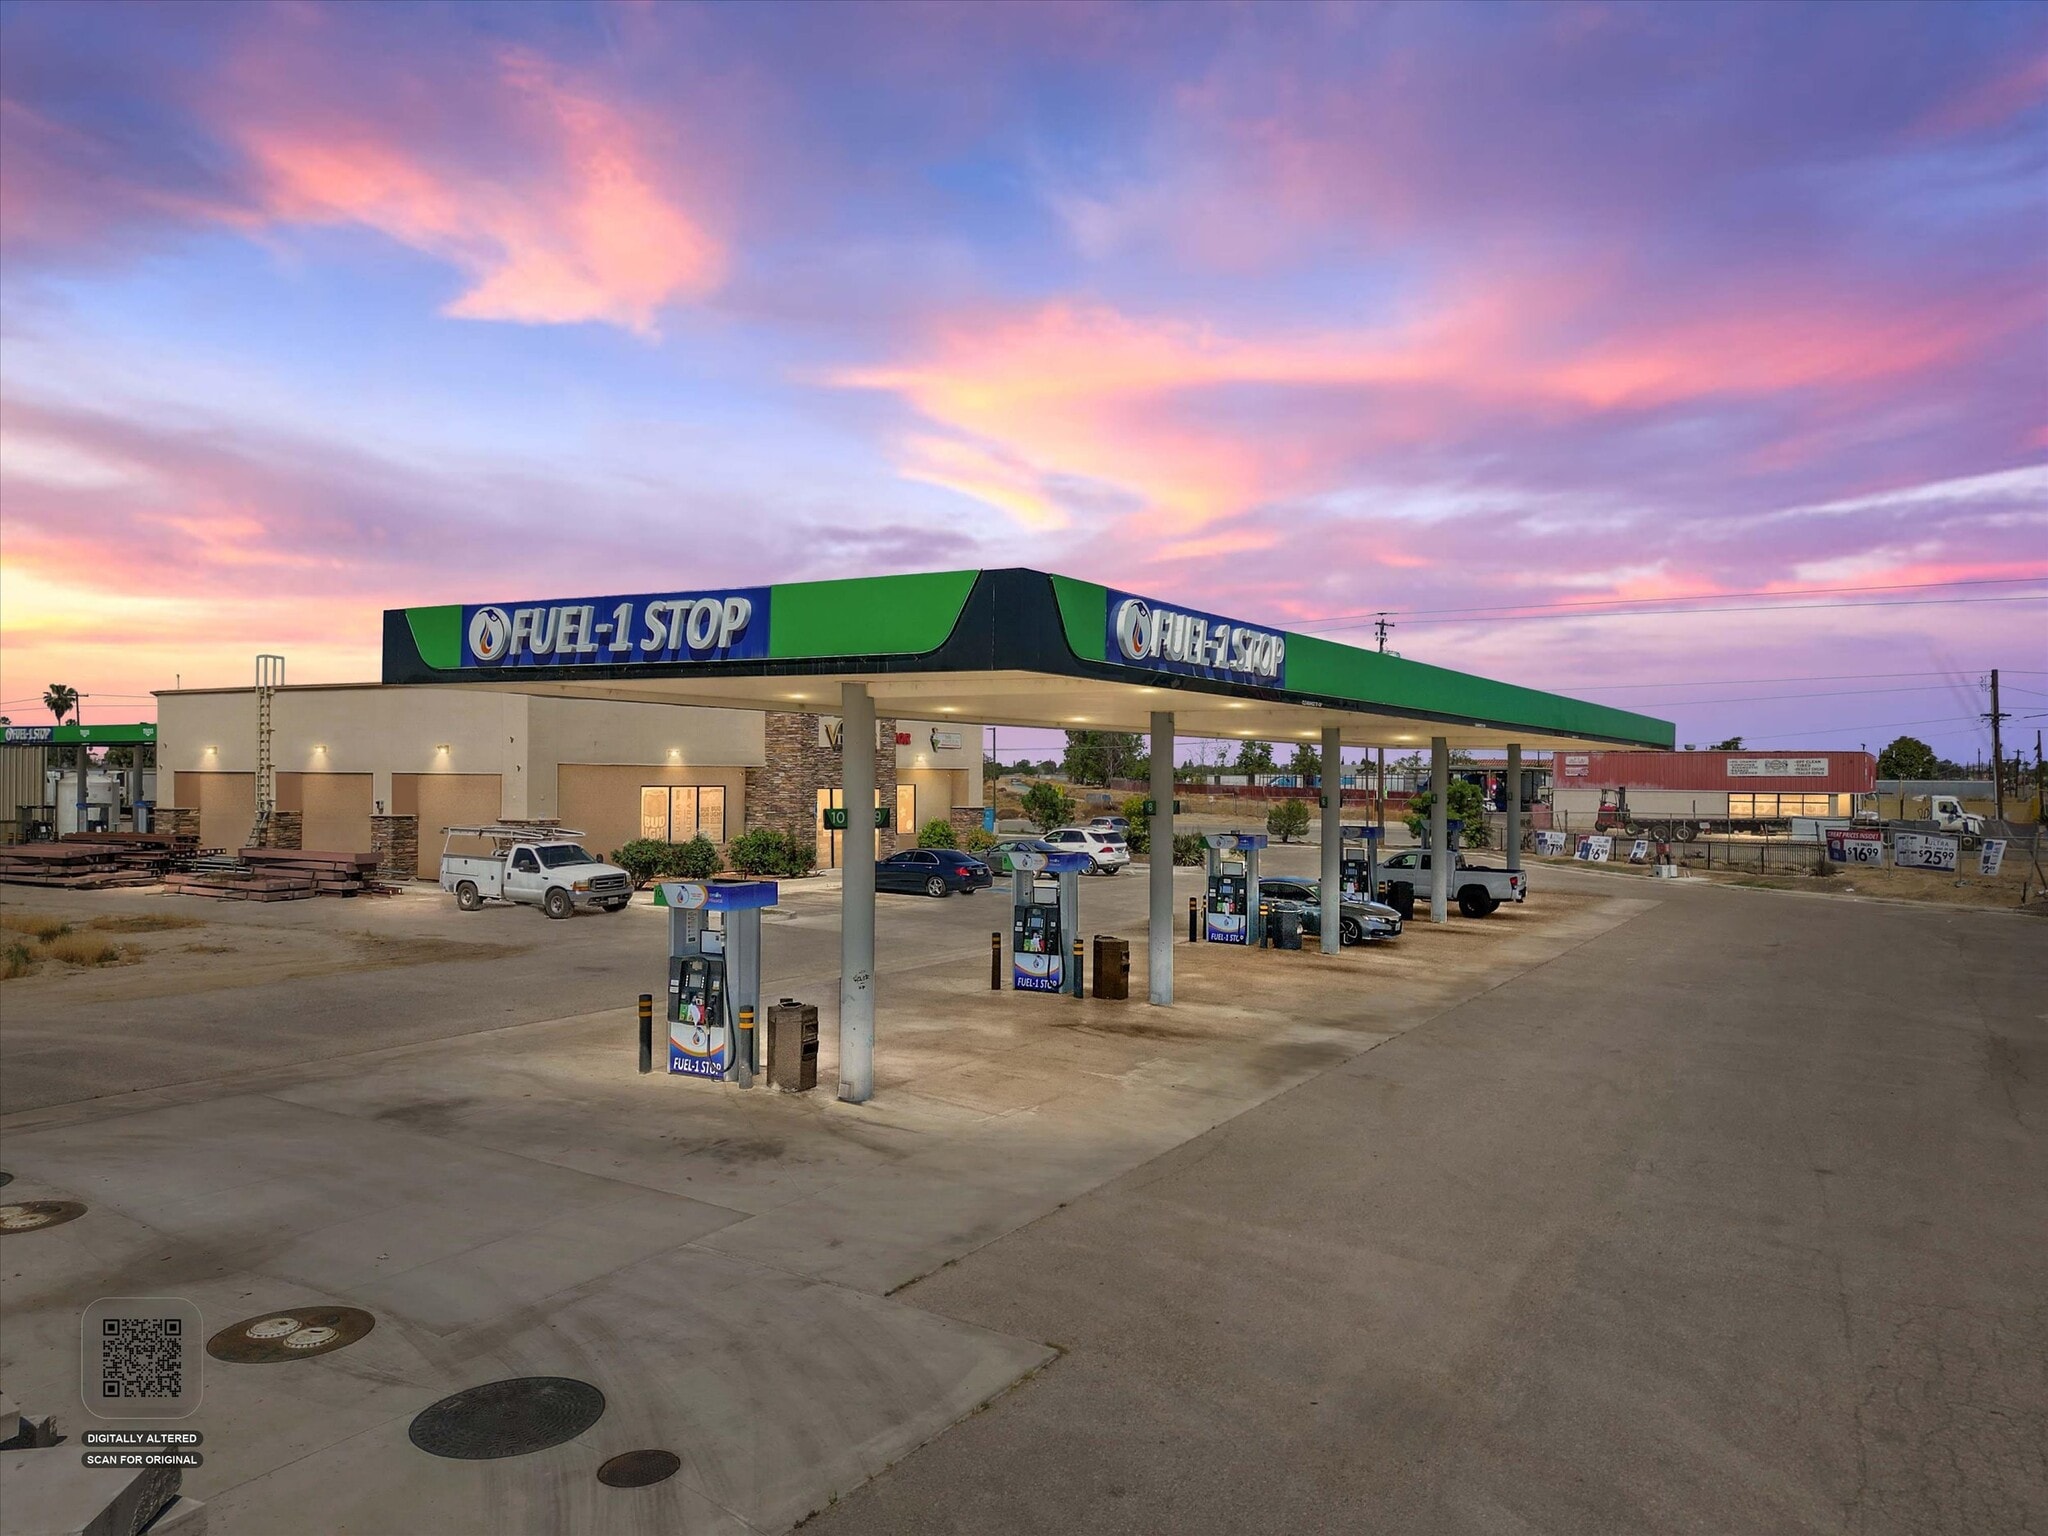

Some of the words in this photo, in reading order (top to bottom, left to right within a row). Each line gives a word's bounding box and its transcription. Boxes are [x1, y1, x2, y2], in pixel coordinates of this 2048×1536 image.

[509, 602, 634, 656] FUEL-1
[640, 596, 752, 652] STOP
[1150, 608, 1230, 669] FUEL-1
[1229, 626, 1285, 678] STOP
[1148, 802, 1153, 812] 8
[644, 815, 666, 829] BUD
[831, 811, 845, 823] 10
[875, 811, 882, 822] 9
[1827, 830, 1842, 838] GREAT
[1017, 977, 1039, 988] FUEL-1
[673, 1057, 699, 1073] FUEL-1
